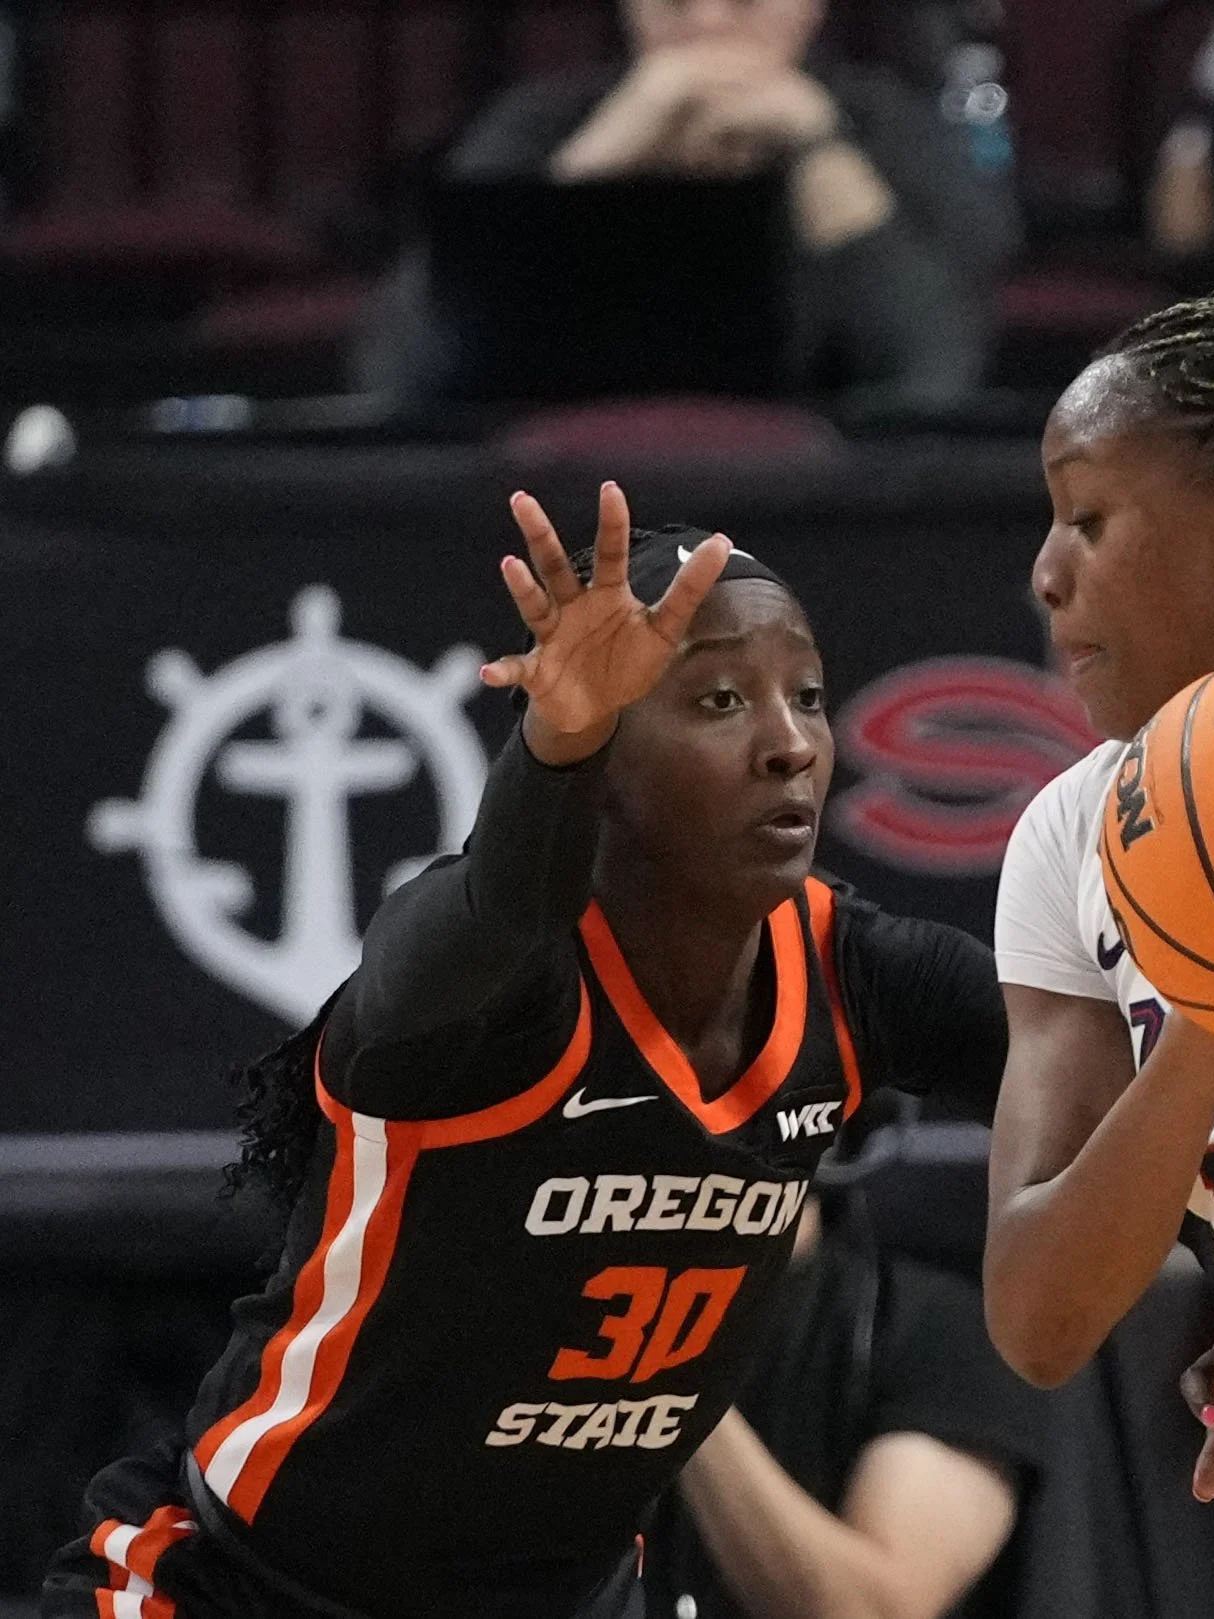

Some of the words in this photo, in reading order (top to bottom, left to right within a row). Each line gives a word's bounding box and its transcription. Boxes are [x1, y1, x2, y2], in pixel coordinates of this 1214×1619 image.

[776, 1101, 842, 1142] WCC
[524, 1174, 809, 1236] OREGON
[548, 1265, 748, 1383] 30
[485, 1393, 699, 1450] STATE
